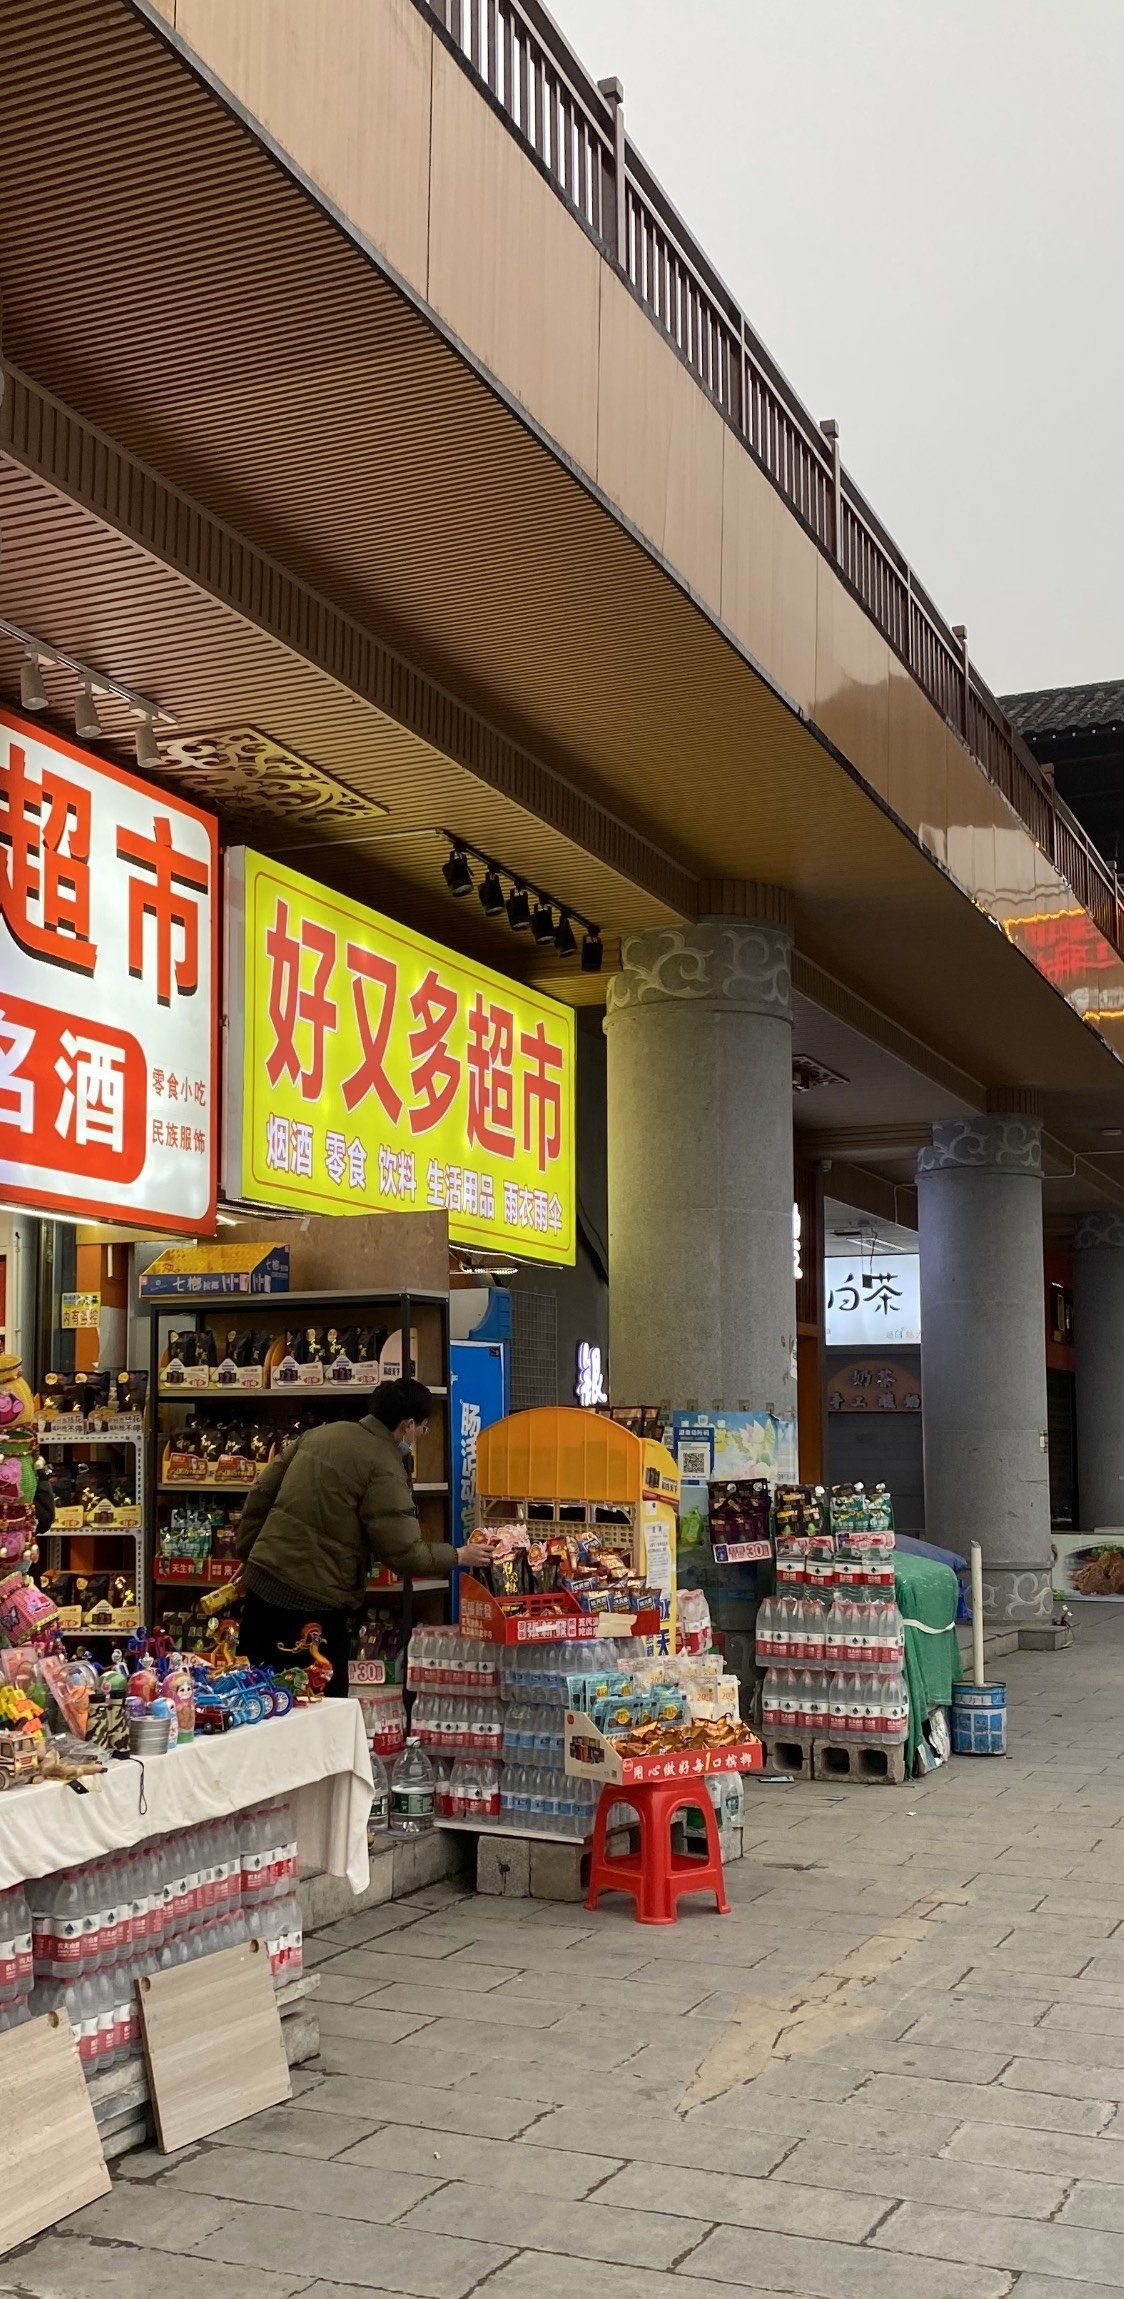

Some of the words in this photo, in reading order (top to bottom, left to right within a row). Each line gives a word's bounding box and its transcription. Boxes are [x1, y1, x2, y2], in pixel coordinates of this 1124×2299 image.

[0, 742, 208, 1007] 超市
[265, 897, 564, 1173] 好又多超市
[152, 1067, 206, 1107] 零食小吃
[152, 1118, 206, 1155] 民族服饰
[266, 1113, 313, 1178] 烟酒
[325, 1131, 367, 1189] 零食
[378, 1144, 416, 1201] 饮料
[427, 1158, 495, 1219] 生活用品
[504, 1180, 563, 1235] 雨衣雨伞
[633, 1752, 754, 1780] 用心做好每1口槟榔
